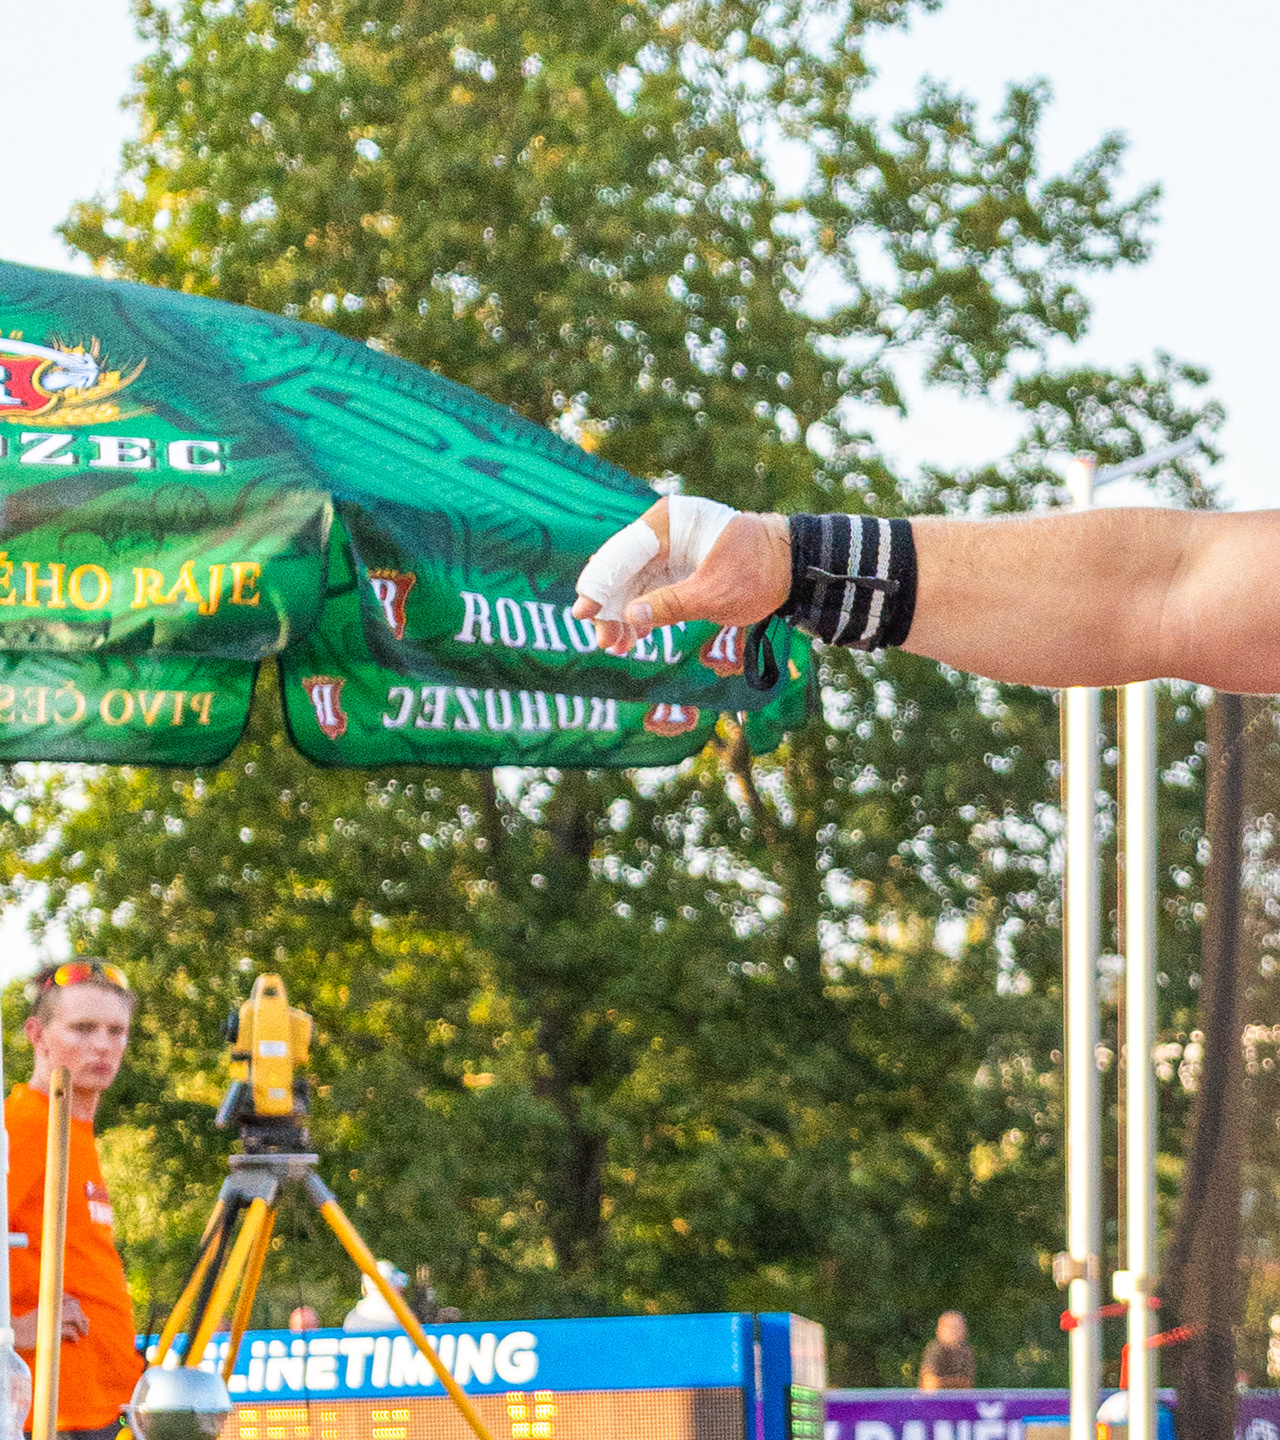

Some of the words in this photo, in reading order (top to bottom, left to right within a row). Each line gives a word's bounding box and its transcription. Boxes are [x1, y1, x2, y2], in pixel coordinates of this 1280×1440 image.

[0, 431, 225, 472] ZEC
[455, 590, 687, 666] ROHOEC
[145, 1331, 538, 1392] LINETIMING
